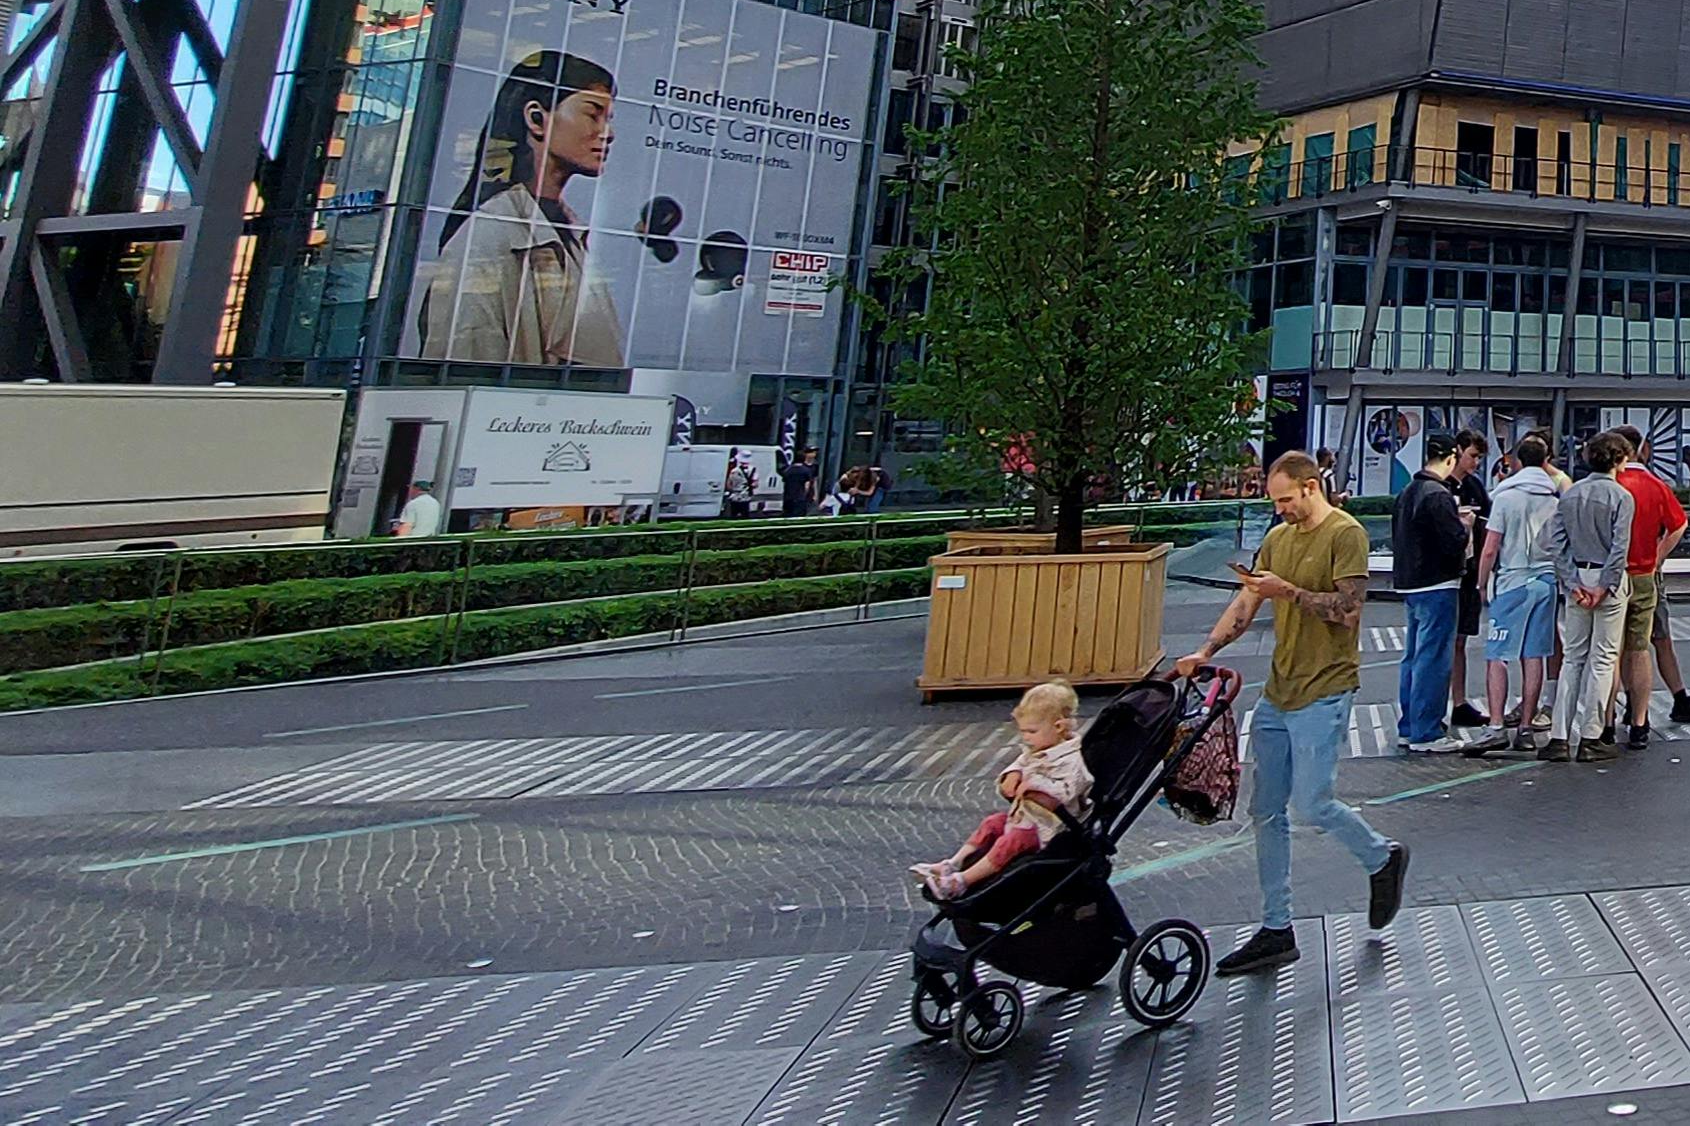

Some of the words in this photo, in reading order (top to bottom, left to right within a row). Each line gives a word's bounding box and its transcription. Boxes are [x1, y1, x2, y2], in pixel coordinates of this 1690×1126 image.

[653, 78, 851, 131] Branchenführendes
[727, 118, 849, 162] Cancellng
[774, 252, 828, 272] CHIP
[486, 416, 551, 434] Leckeres
[558, 418, 652, 436] Backschwein
